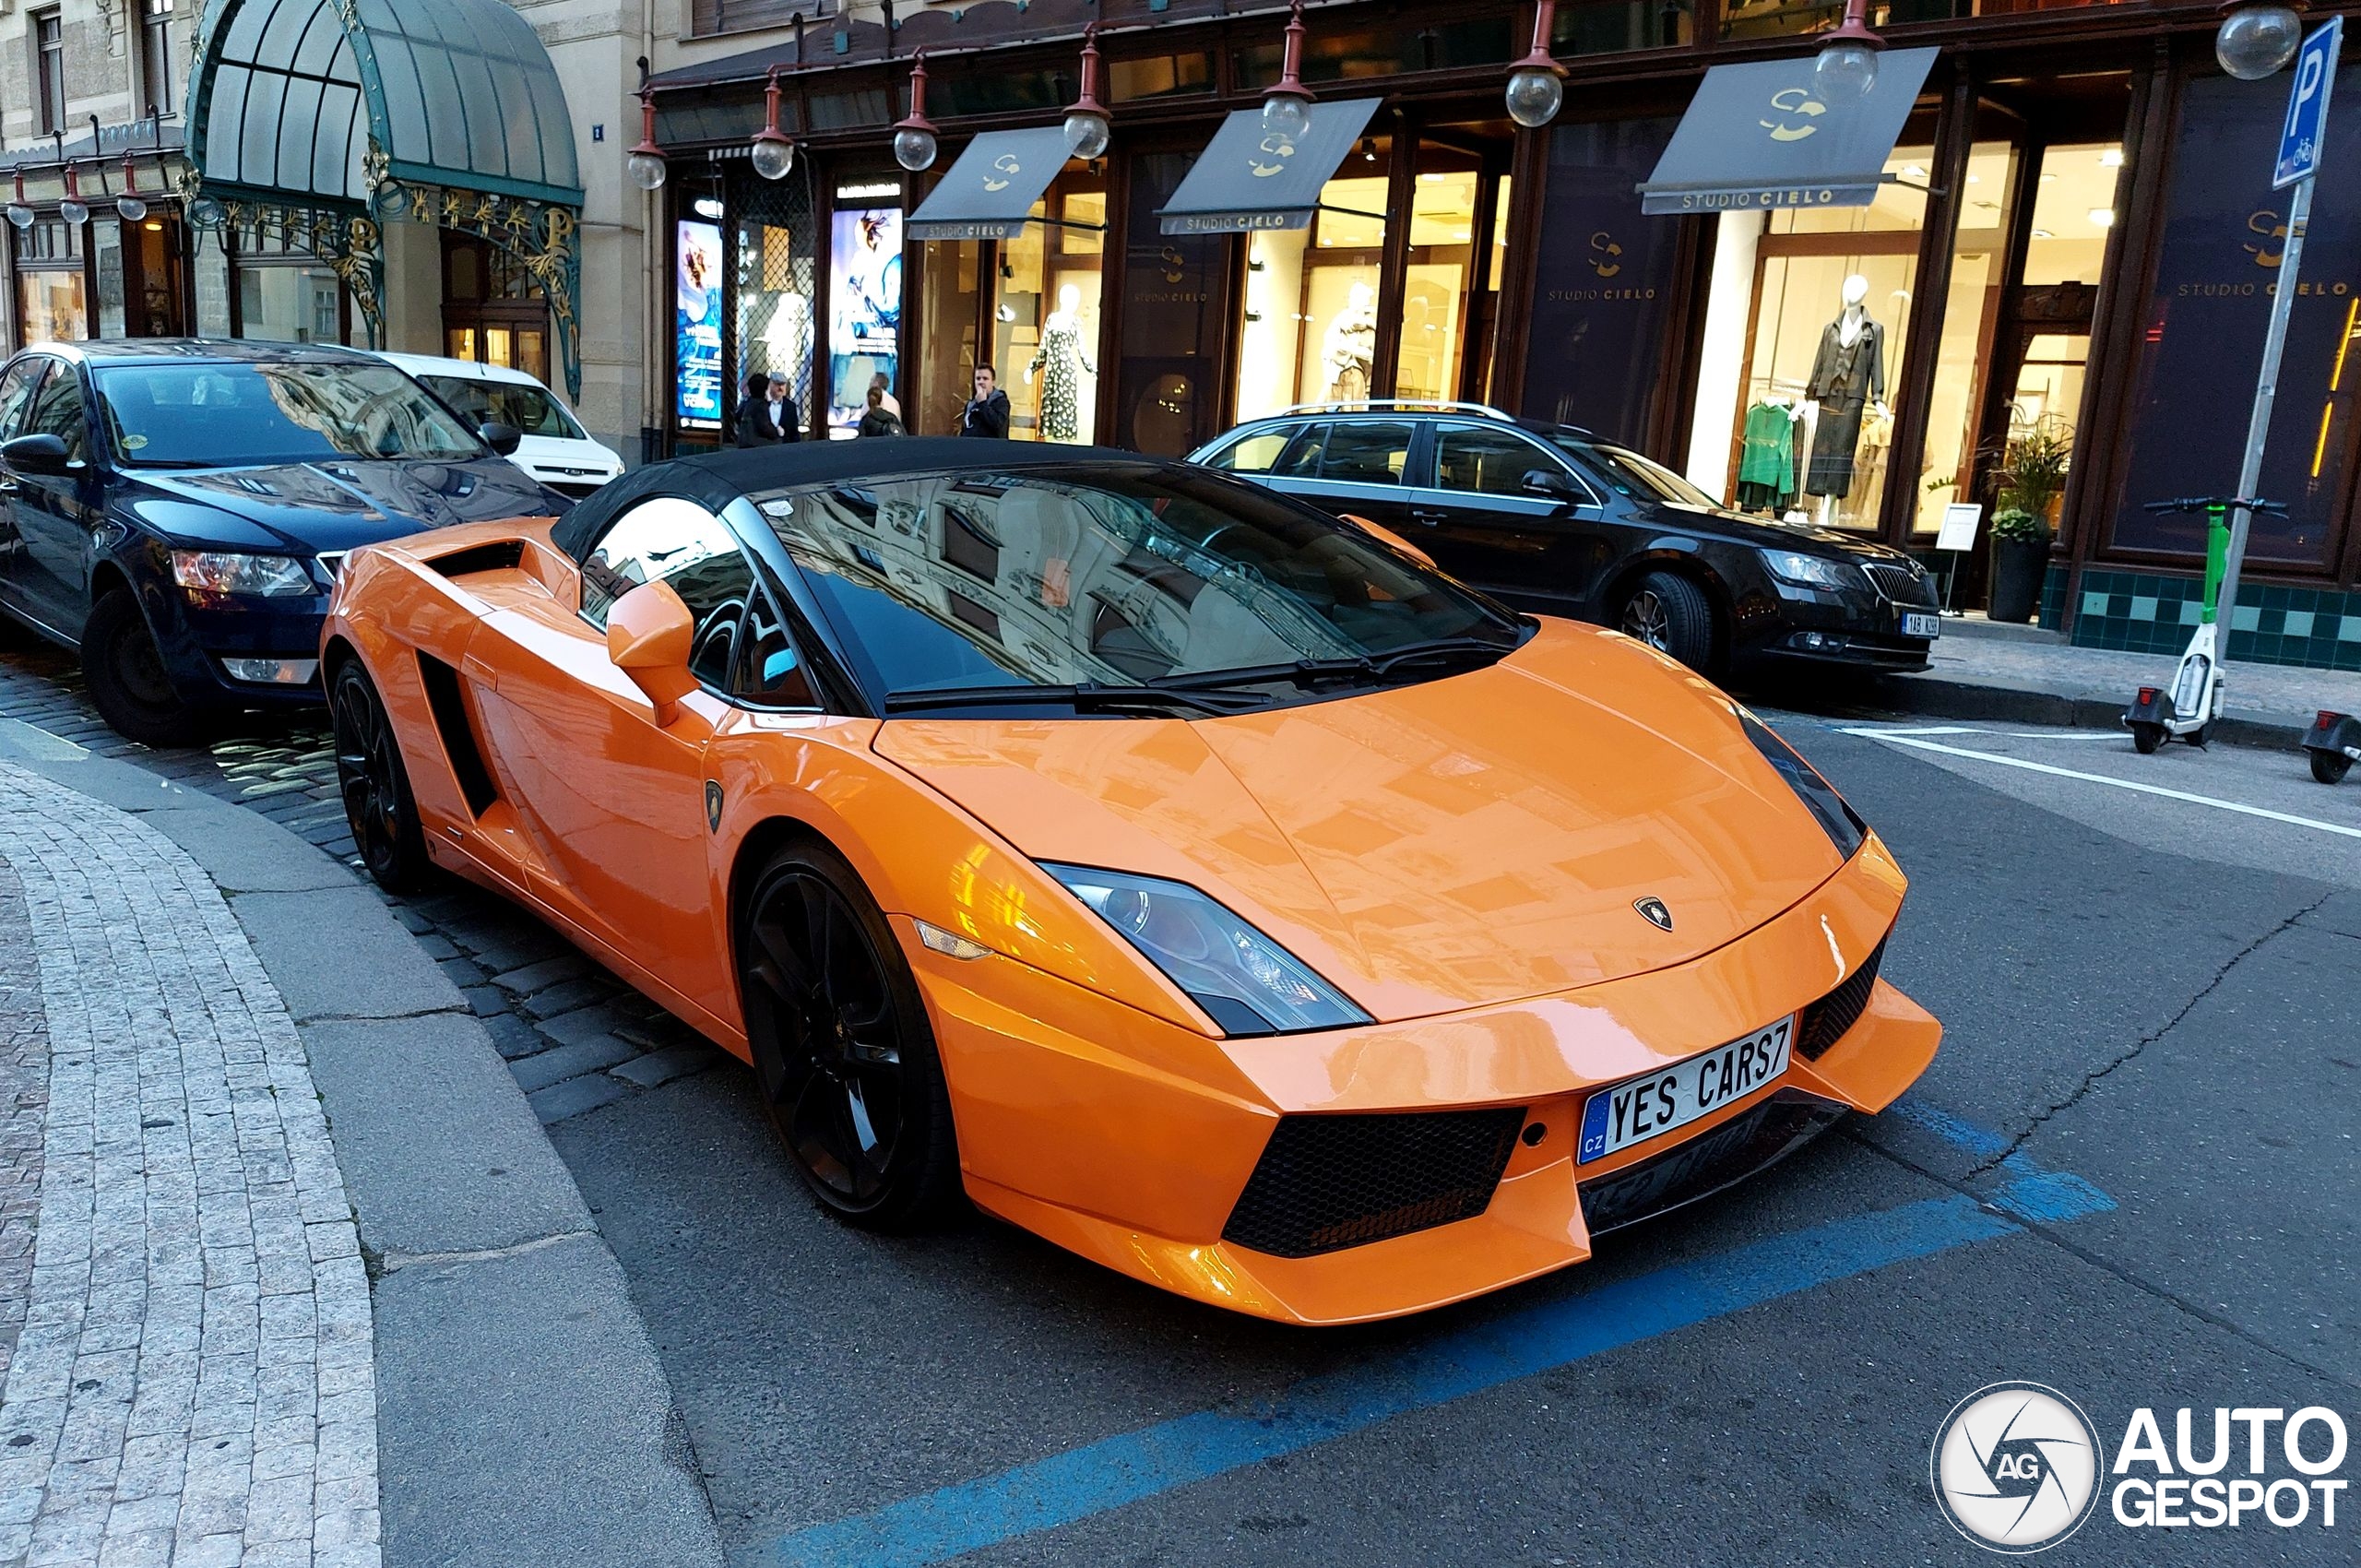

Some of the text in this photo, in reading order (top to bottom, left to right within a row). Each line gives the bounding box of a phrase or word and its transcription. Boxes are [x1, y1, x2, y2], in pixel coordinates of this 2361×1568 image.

[2290, 49, 2323, 137] P
[1682, 190, 1833, 208] STUDIO CIELO
[1187, 216, 1284, 230] STUDIO CIELO
[929, 226, 1004, 236] STUDIO CIELO
[1549, 289, 1655, 301] STUDIO CIELO
[2178, 282, 2347, 296] STUDIO CELO
[1171, 293, 1207, 302] CIELO
[1614, 1022, 1789, 1143] YES CARS7
[1584, 1134, 1604, 1153] CZ
